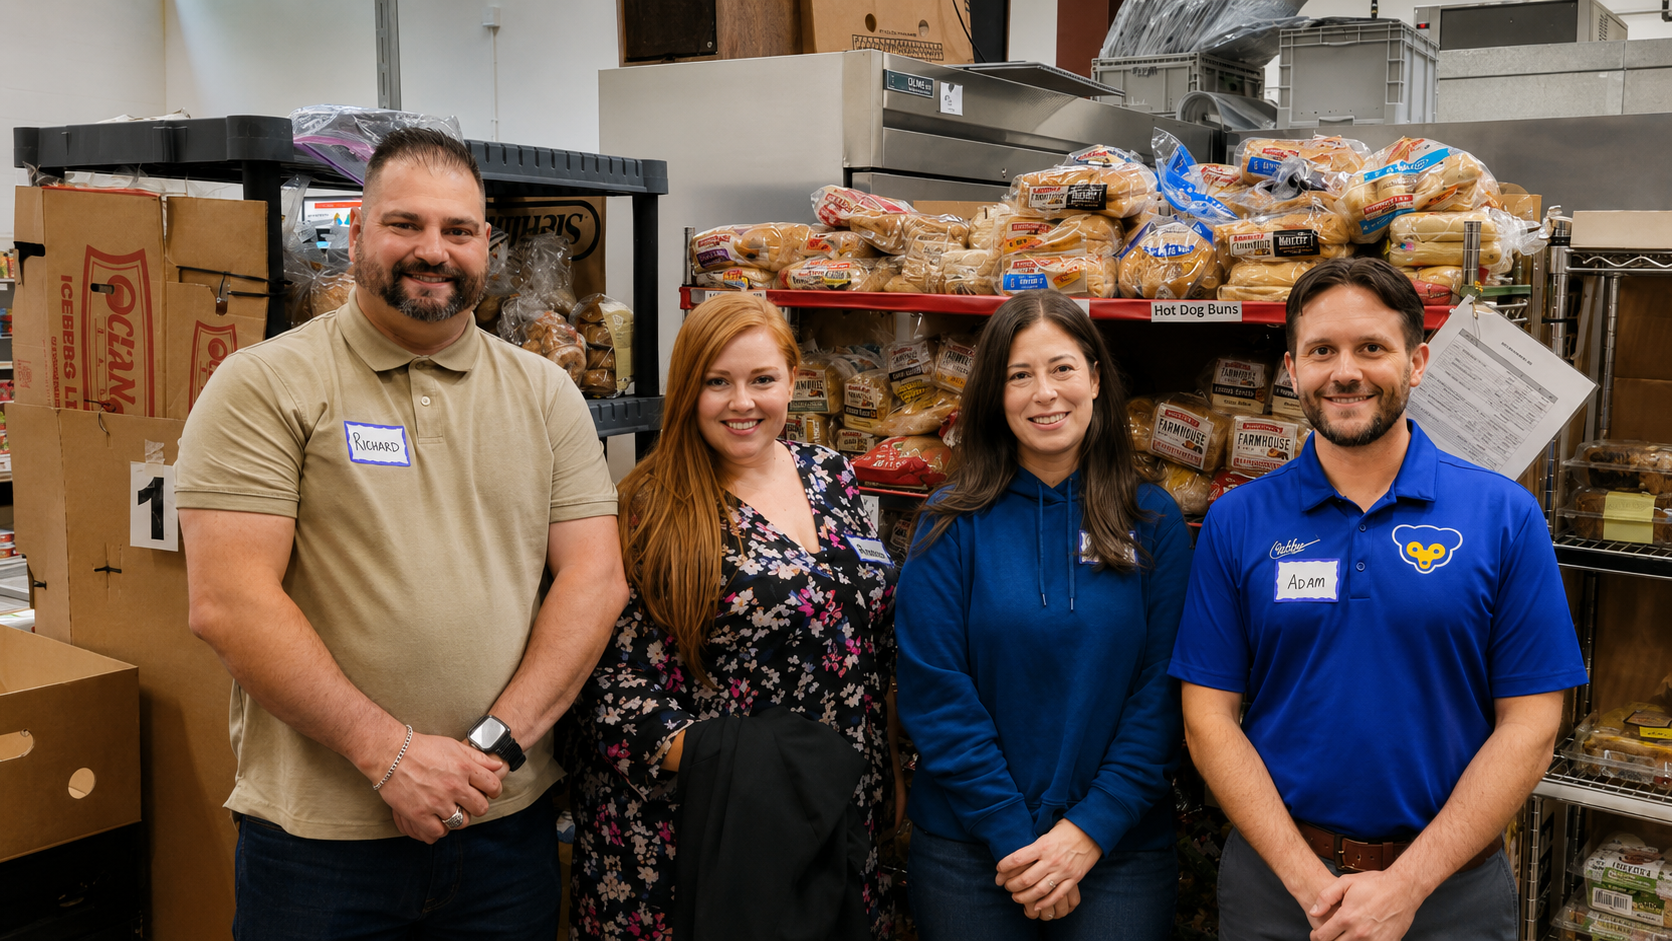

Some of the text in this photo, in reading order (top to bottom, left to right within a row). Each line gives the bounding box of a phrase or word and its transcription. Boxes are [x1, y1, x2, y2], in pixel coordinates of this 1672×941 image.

[1154, 303, 1239, 317] Hot Dog Buns
[1158, 418, 1206, 446] FARMHOUSE
[353, 432, 400, 452] RICHARD
[1238, 433, 1291, 451] FARMHOUSE
[137, 476, 165, 541] 1
[1287, 574, 1326, 590] ADAM
